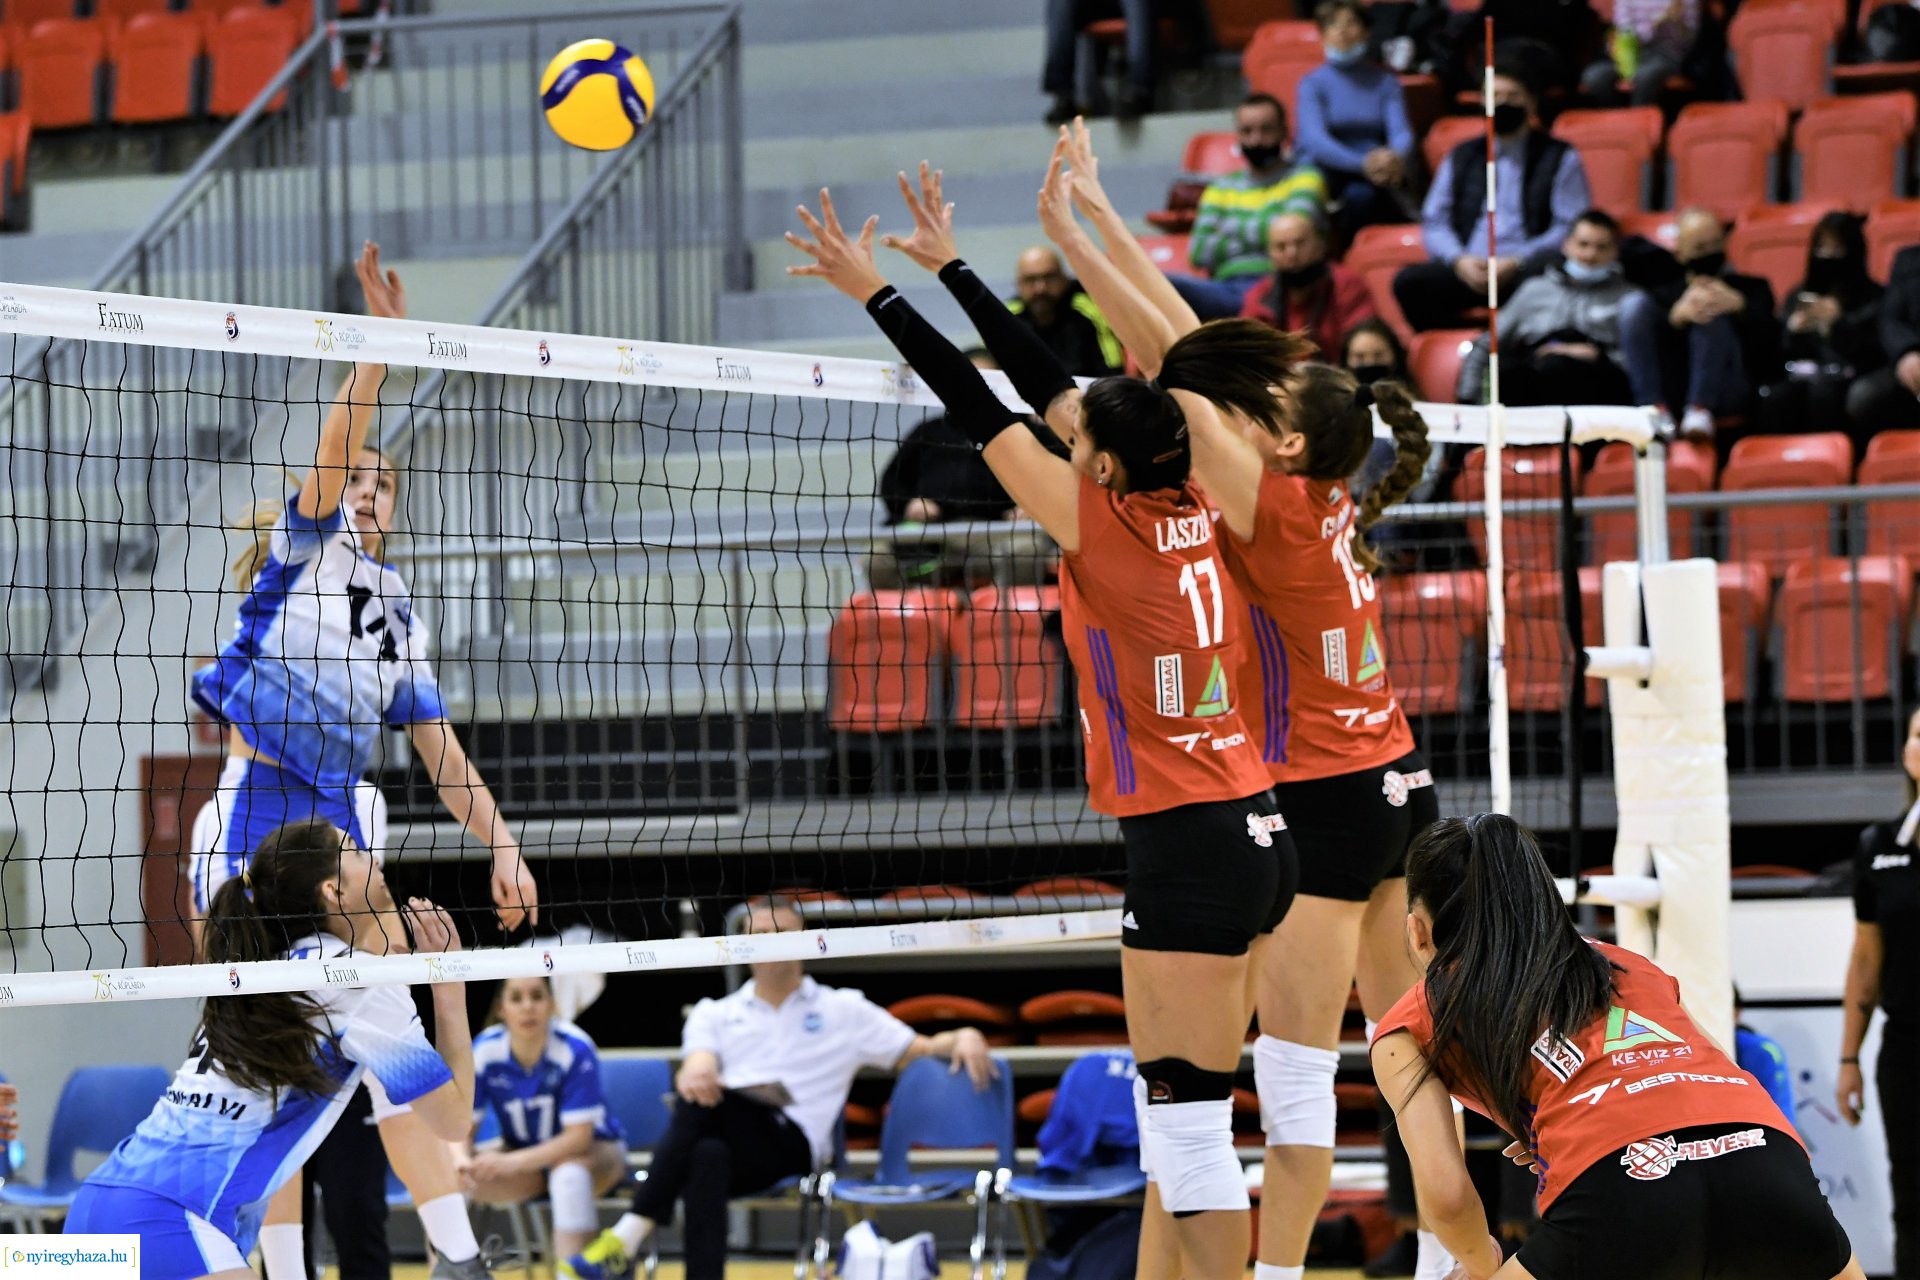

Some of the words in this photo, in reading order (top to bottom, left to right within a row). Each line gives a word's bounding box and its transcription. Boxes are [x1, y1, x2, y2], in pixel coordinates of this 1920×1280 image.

[97, 302, 144, 331] FATUM
[427, 332, 467, 358] FATUM
[1178, 556, 1224, 649] 17
[1164, 658, 1176, 714] STRABAG
[323, 964, 359, 983] FATUM
[1611, 1048, 1671, 1067] KE-VIZ
[1672, 1045, 1693, 1058] 21
[1624, 1071, 1749, 1095] BESTRONG
[504, 1094, 555, 1142] 17
